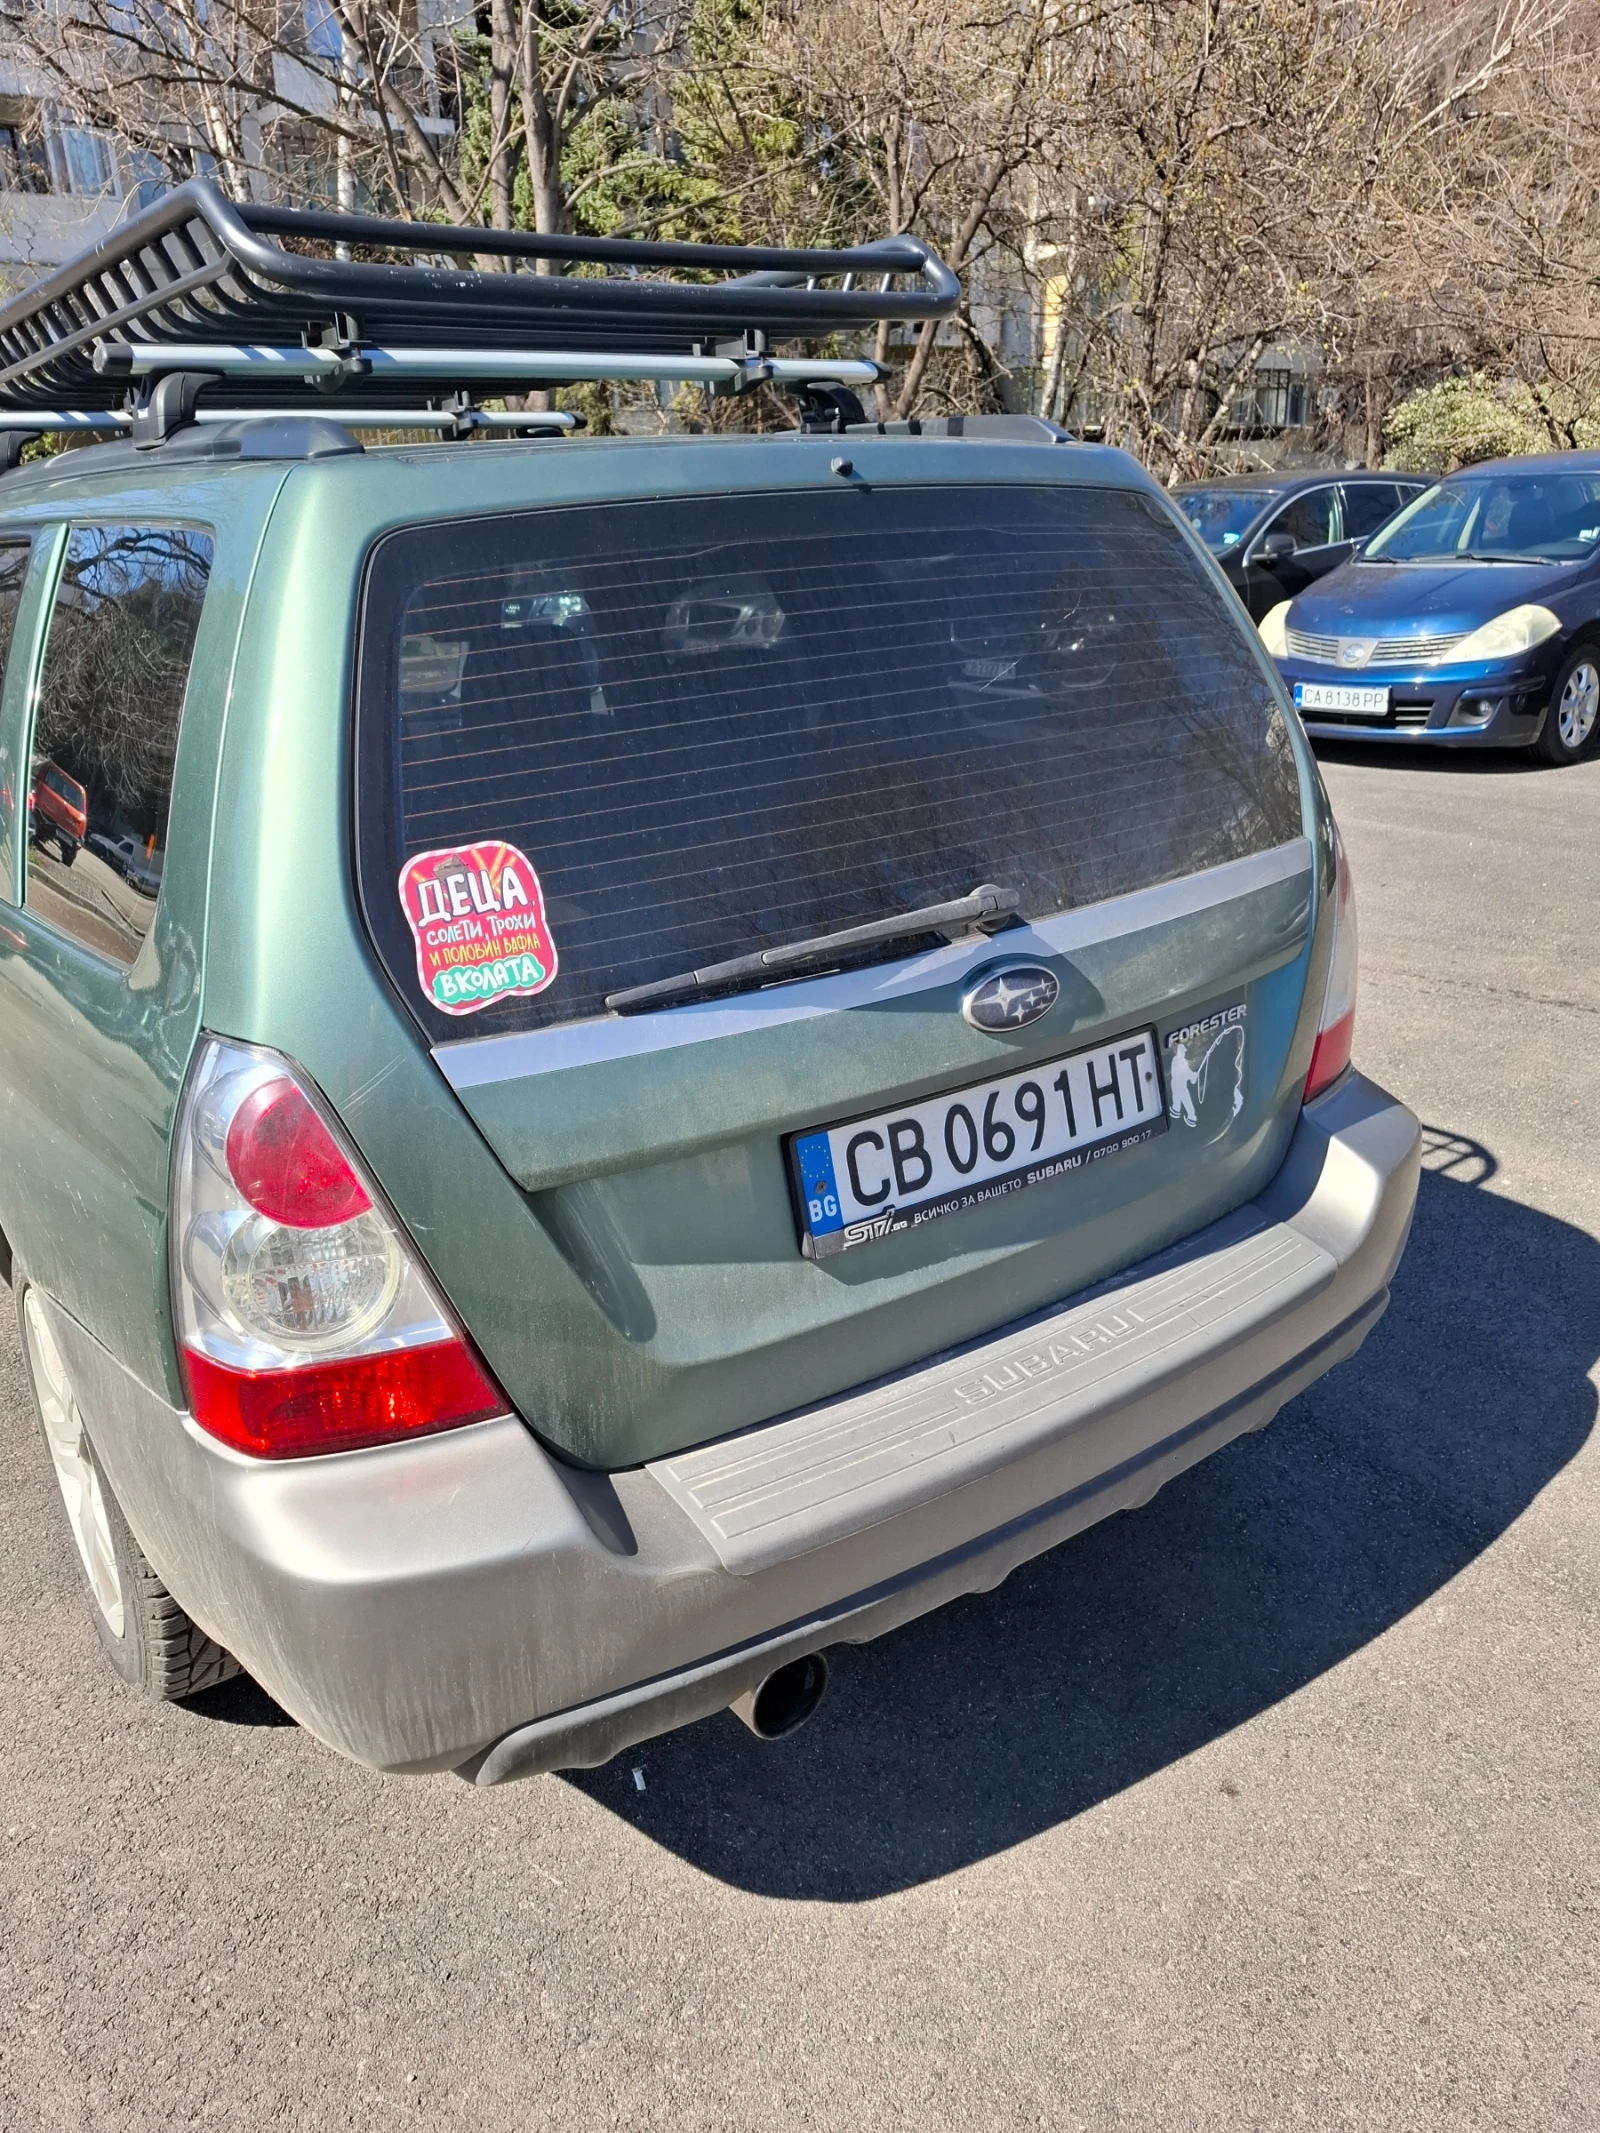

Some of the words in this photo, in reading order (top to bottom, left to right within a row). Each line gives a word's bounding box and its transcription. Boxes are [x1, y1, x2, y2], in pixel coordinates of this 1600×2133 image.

[1325, 690, 1360, 707] 8138
[488, 912, 537, 937] ТРОХИ
[429, 952, 441, 967] И
[443, 938, 502, 965] ПОЛОВИН
[504, 932, 541, 953] ВАФЛА
[1166, 1003, 1248, 1049] FORESTER
[944, 1069, 1078, 1175] 0691
[914, 1200, 960, 1224] ВСИЧКО
[961, 1193, 976, 1208] ЗА
[978, 1178, 1022, 1202] ВАШЕТО
[1027, 1155, 1082, 1185] SUBARU
[1093, 1142, 1120, 1159] 0700
[1121, 1135, 1140, 1149] 900
[1141, 1129, 1152, 1141] 17
[808, 1194, 838, 1223] BG
[954, 1314, 1136, 1405] SUBARU
